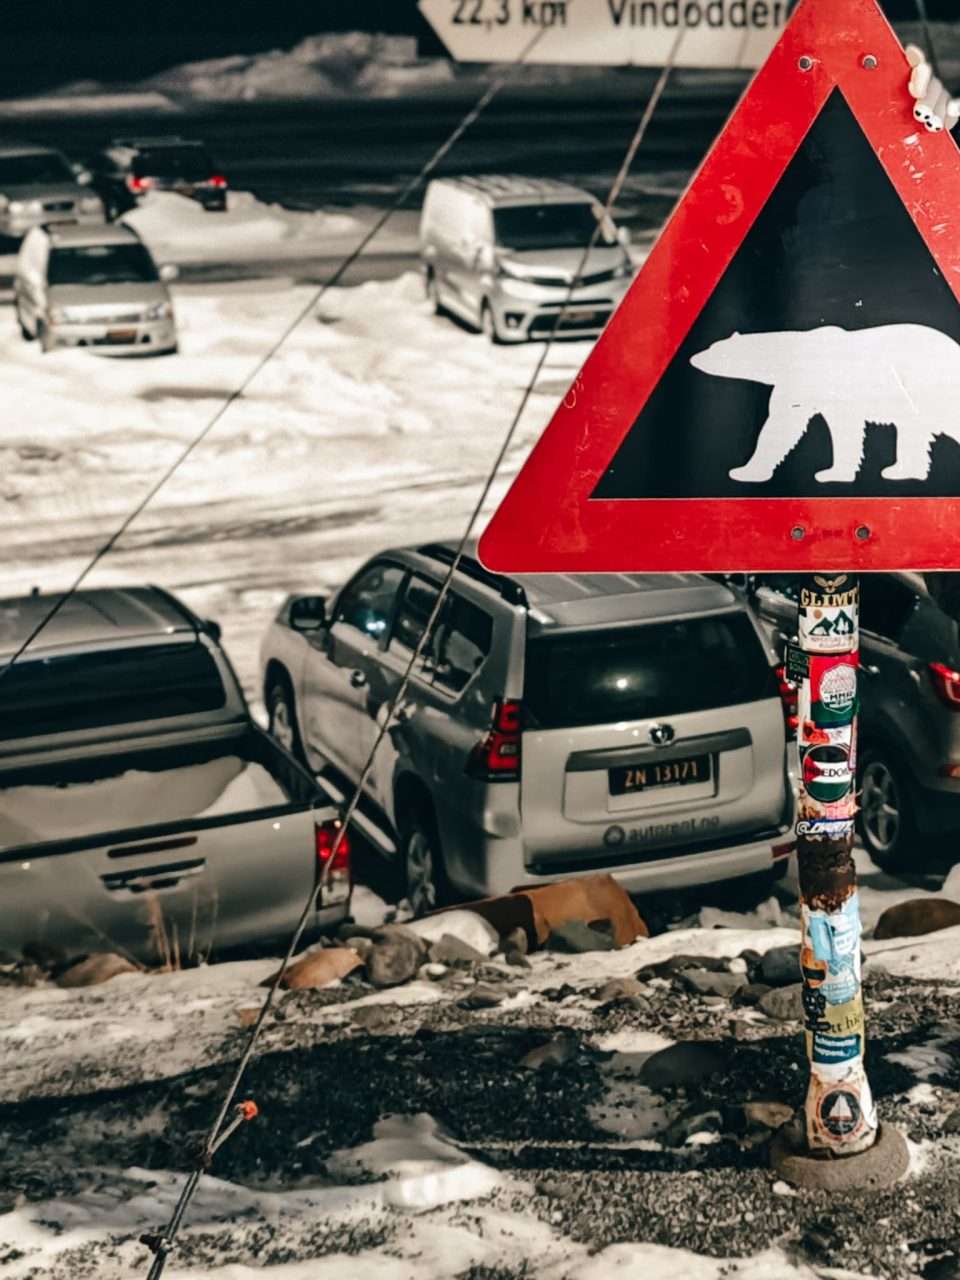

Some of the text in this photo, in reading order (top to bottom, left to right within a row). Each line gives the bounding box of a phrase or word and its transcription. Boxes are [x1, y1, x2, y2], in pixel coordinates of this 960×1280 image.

[800, 587, 859, 608] GLIMT
[624, 761, 698, 788] ZN 13171
